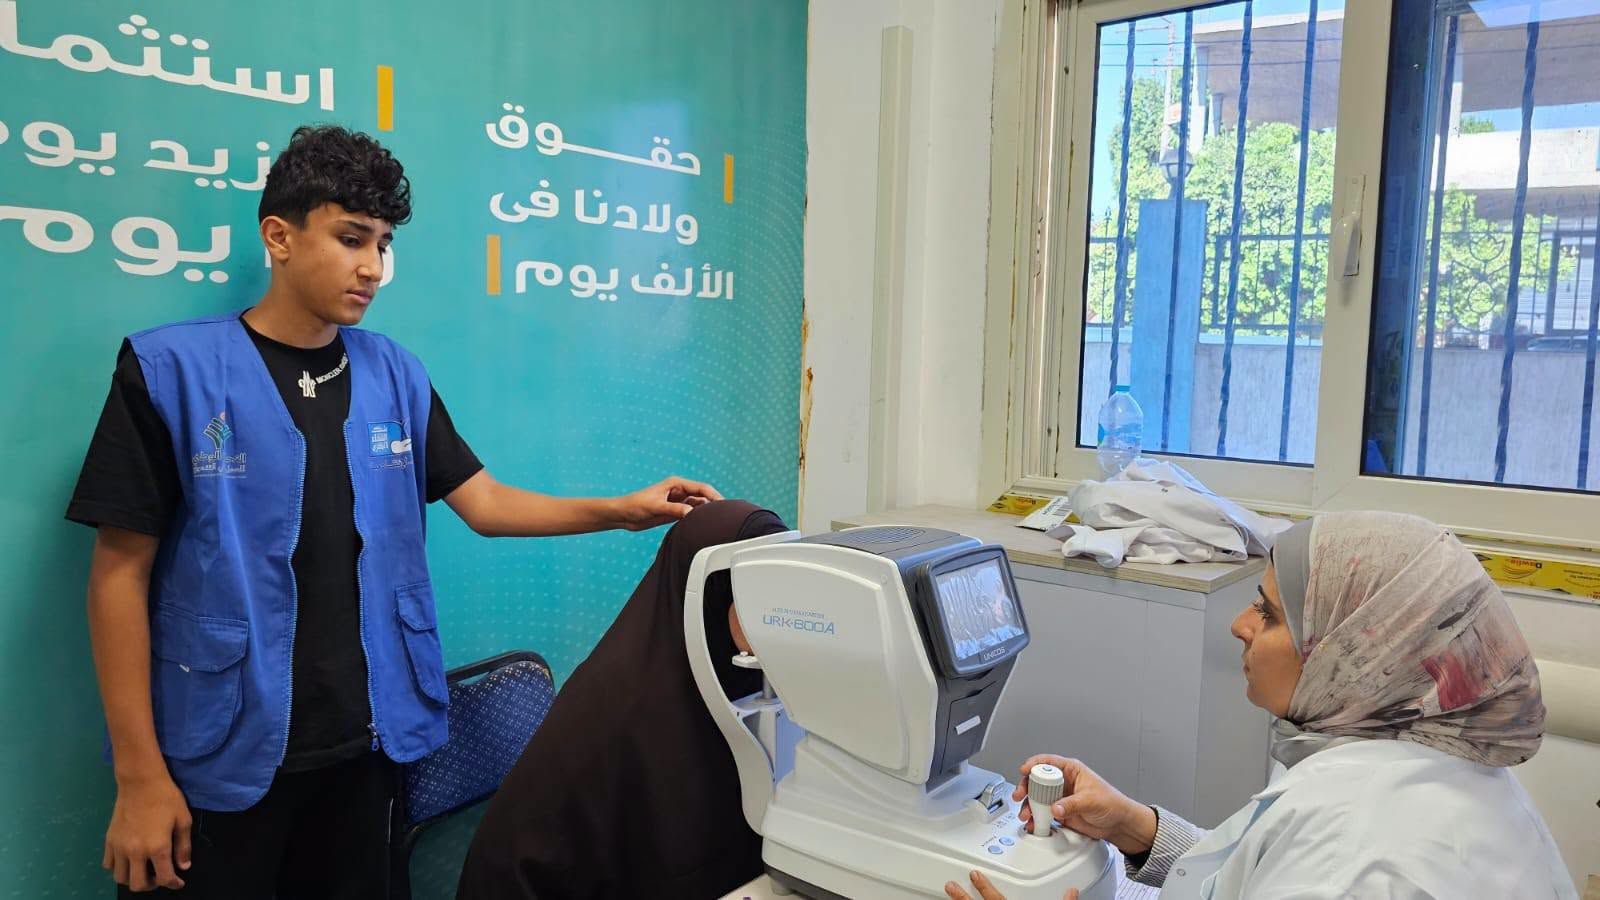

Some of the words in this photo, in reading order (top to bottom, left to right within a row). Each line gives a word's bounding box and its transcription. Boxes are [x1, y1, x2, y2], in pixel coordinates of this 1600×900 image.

[485, 102, 701, 176] حقوق
[144, 140, 272, 191] زيد
[490, 179, 560, 223] فى
[575, 189, 699, 245] ولادنا
[515, 260, 620, 301] يوم
[631, 262, 734, 300] الألف
[983, 646, 1006, 661] UNICOS
